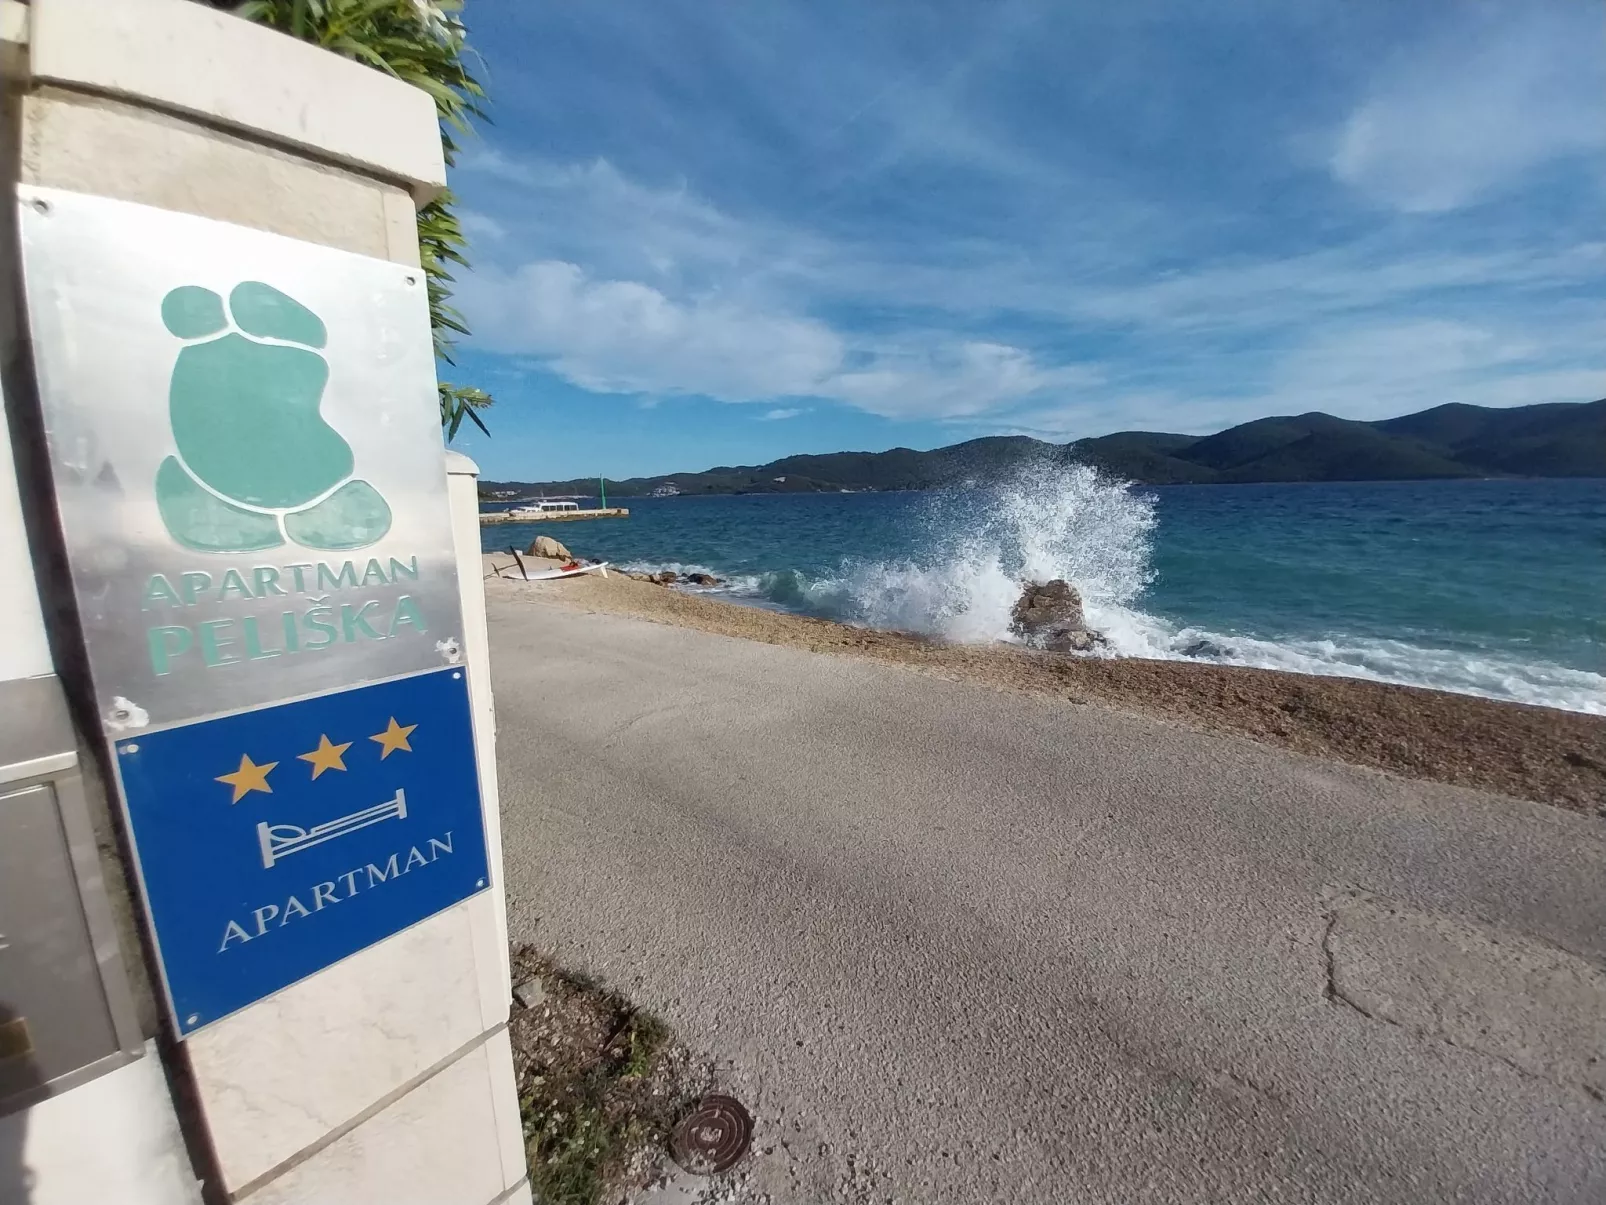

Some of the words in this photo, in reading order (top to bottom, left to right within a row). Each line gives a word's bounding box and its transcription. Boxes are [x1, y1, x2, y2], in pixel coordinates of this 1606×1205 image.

[145, 555, 420, 608] APARTMAN
[148, 595, 429, 676] PELIŠKA
[217, 831, 455, 953] APARTMAN
